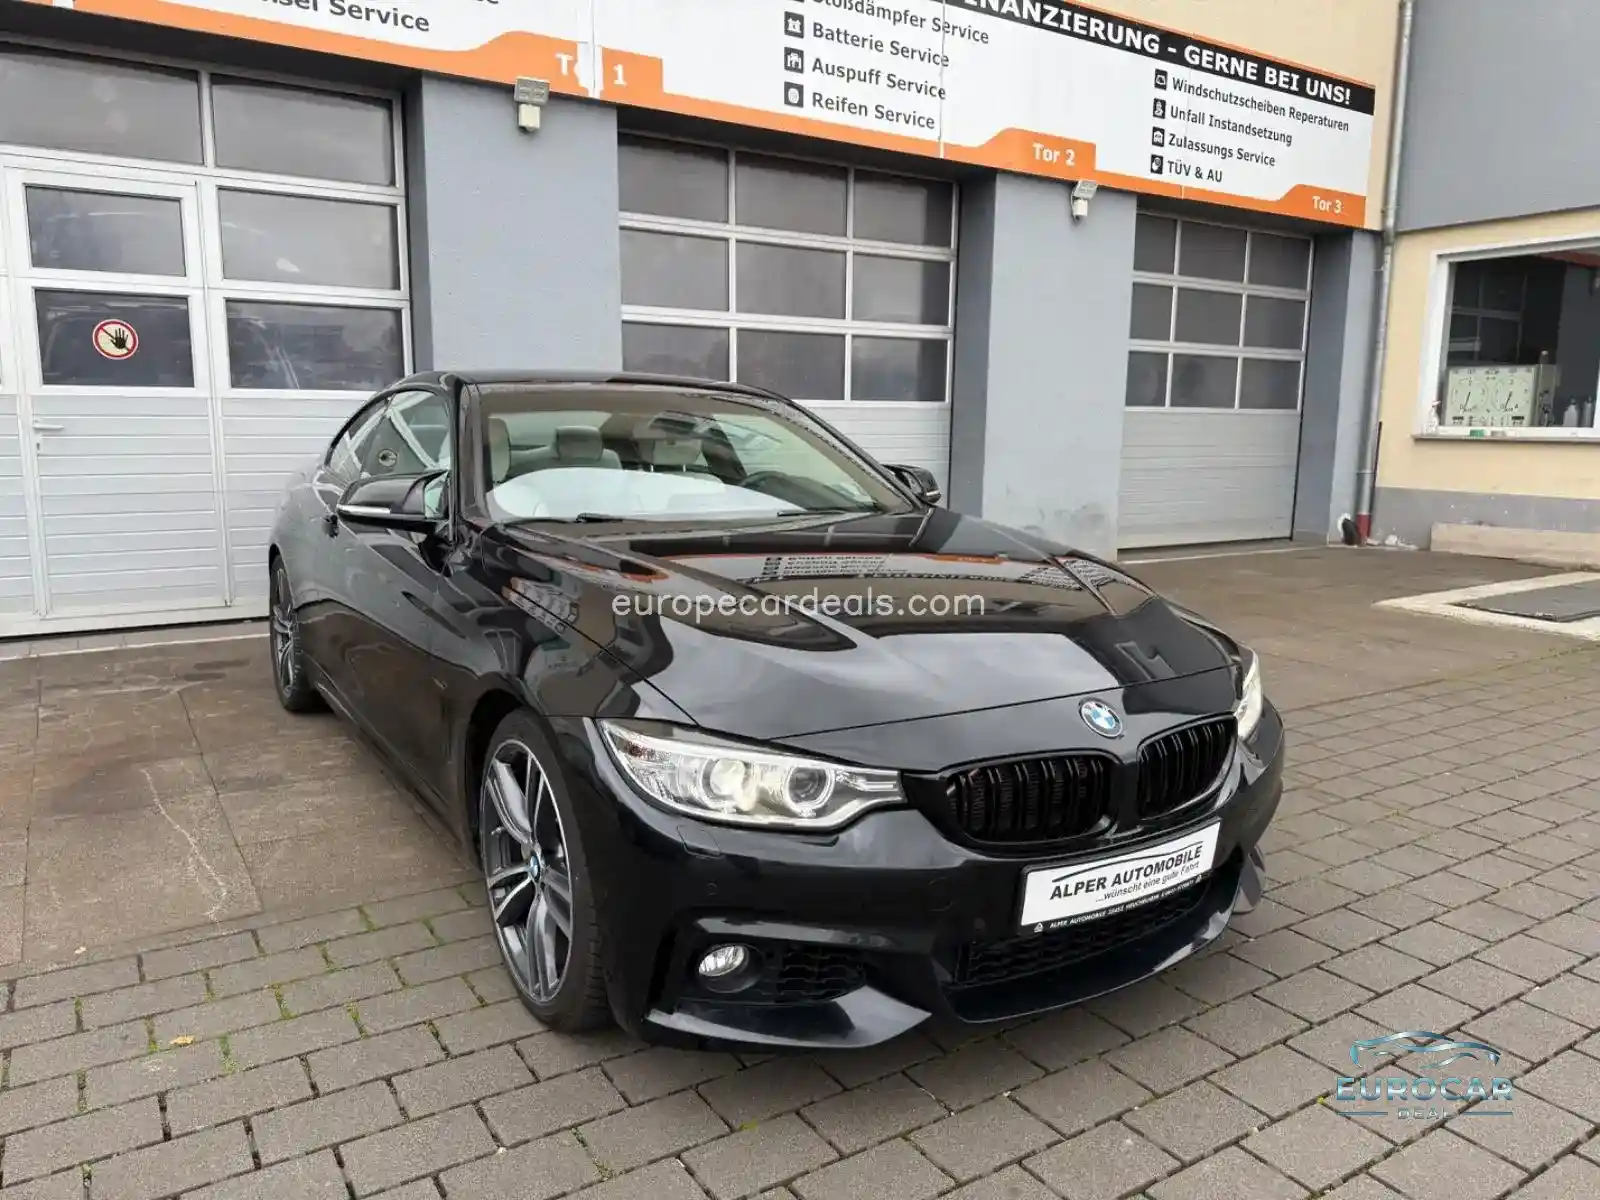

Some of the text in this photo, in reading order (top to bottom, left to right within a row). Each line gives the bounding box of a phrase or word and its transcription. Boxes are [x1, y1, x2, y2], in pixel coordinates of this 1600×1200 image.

[329, 0, 430, 32] Service
[812, 0, 989, 44] oßdämpfer Service
[812, 22, 949, 67] Batterie Service
[613, 64, 627, 86] 1
[812, 57, 946, 100] Auspuff Service
[1184, 45, 1258, 80] GERNE
[1264, 66, 1300, 92] BEI
[1305, 78, 1351, 105] UNS!
[812, 92, 935, 130] Reifen Service
[1172, 77, 1349, 132] Windschutzscheiben Reperaturen
[1170, 105, 1293, 147] Unfall Instandsetzung
[1032, 143, 1076, 167] Tor 2
[1167, 157, 1223, 183] TÜV & AU
[1168, 133, 1276, 167] Zulassungs Service
[1312, 195, 1342, 214] Tor 3
[1049, 876, 1107, 900] ALPER
[1111, 845, 1203, 888] AUTOMOBILE
